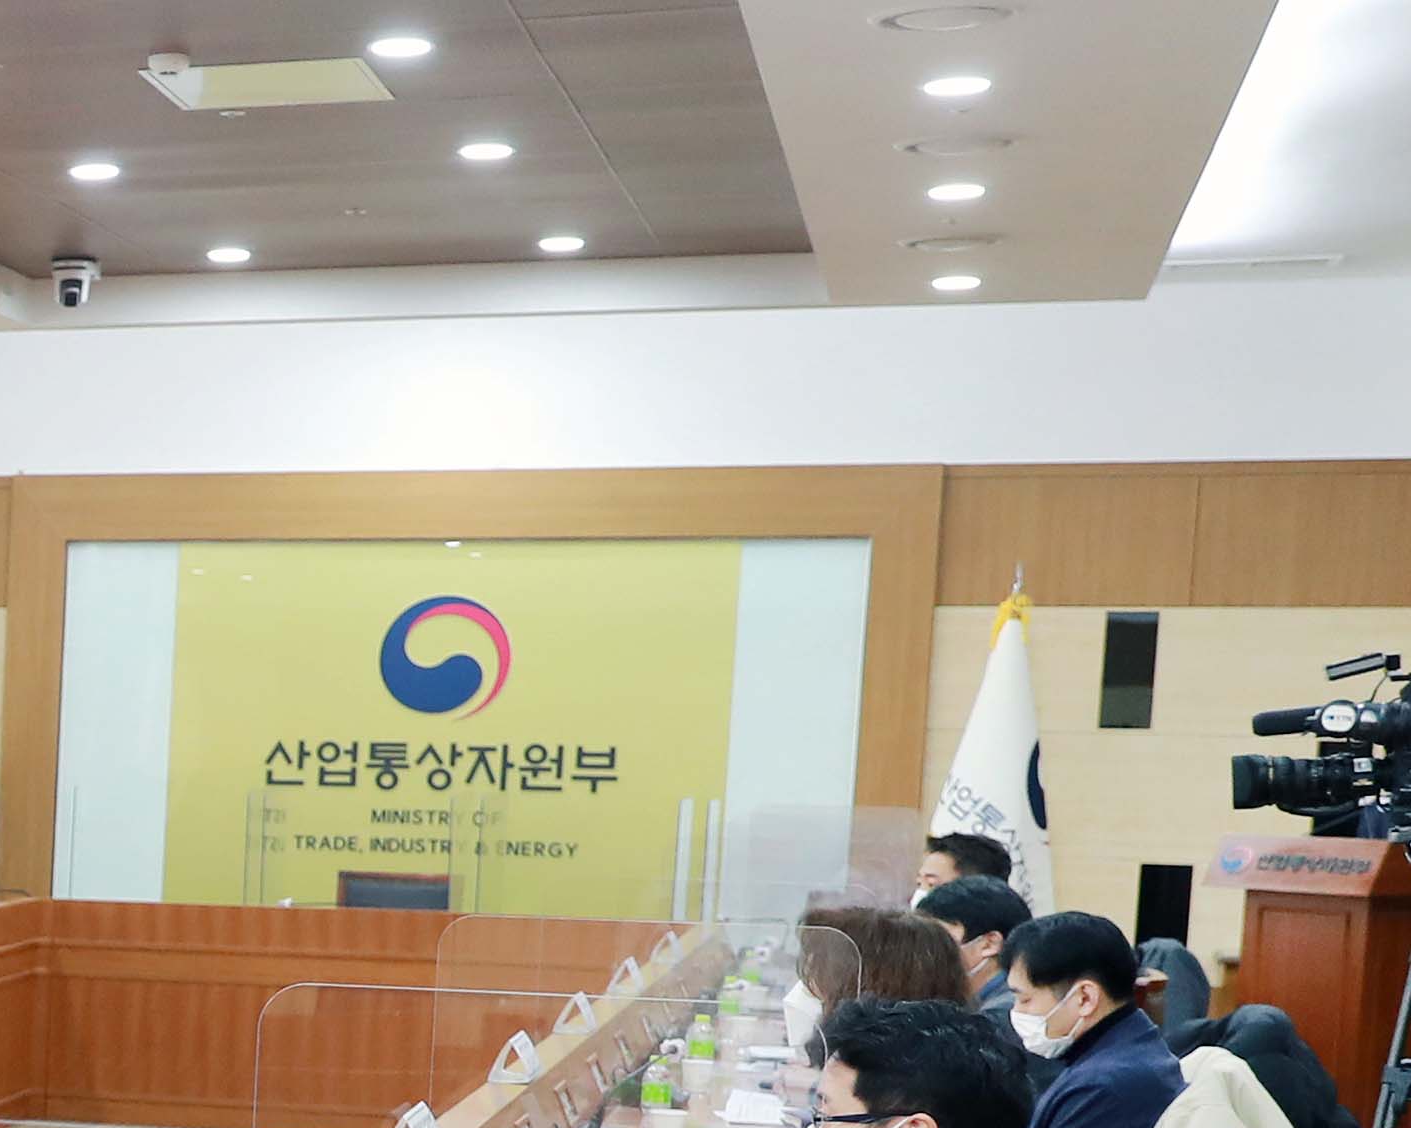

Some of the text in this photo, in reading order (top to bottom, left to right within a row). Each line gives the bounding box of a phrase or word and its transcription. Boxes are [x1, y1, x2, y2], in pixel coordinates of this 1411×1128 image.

[264, 740, 619, 794] 산업통상자원부
[370, 808, 463, 825] MINISTR
[370, 837, 464, 854] INDUSTR
